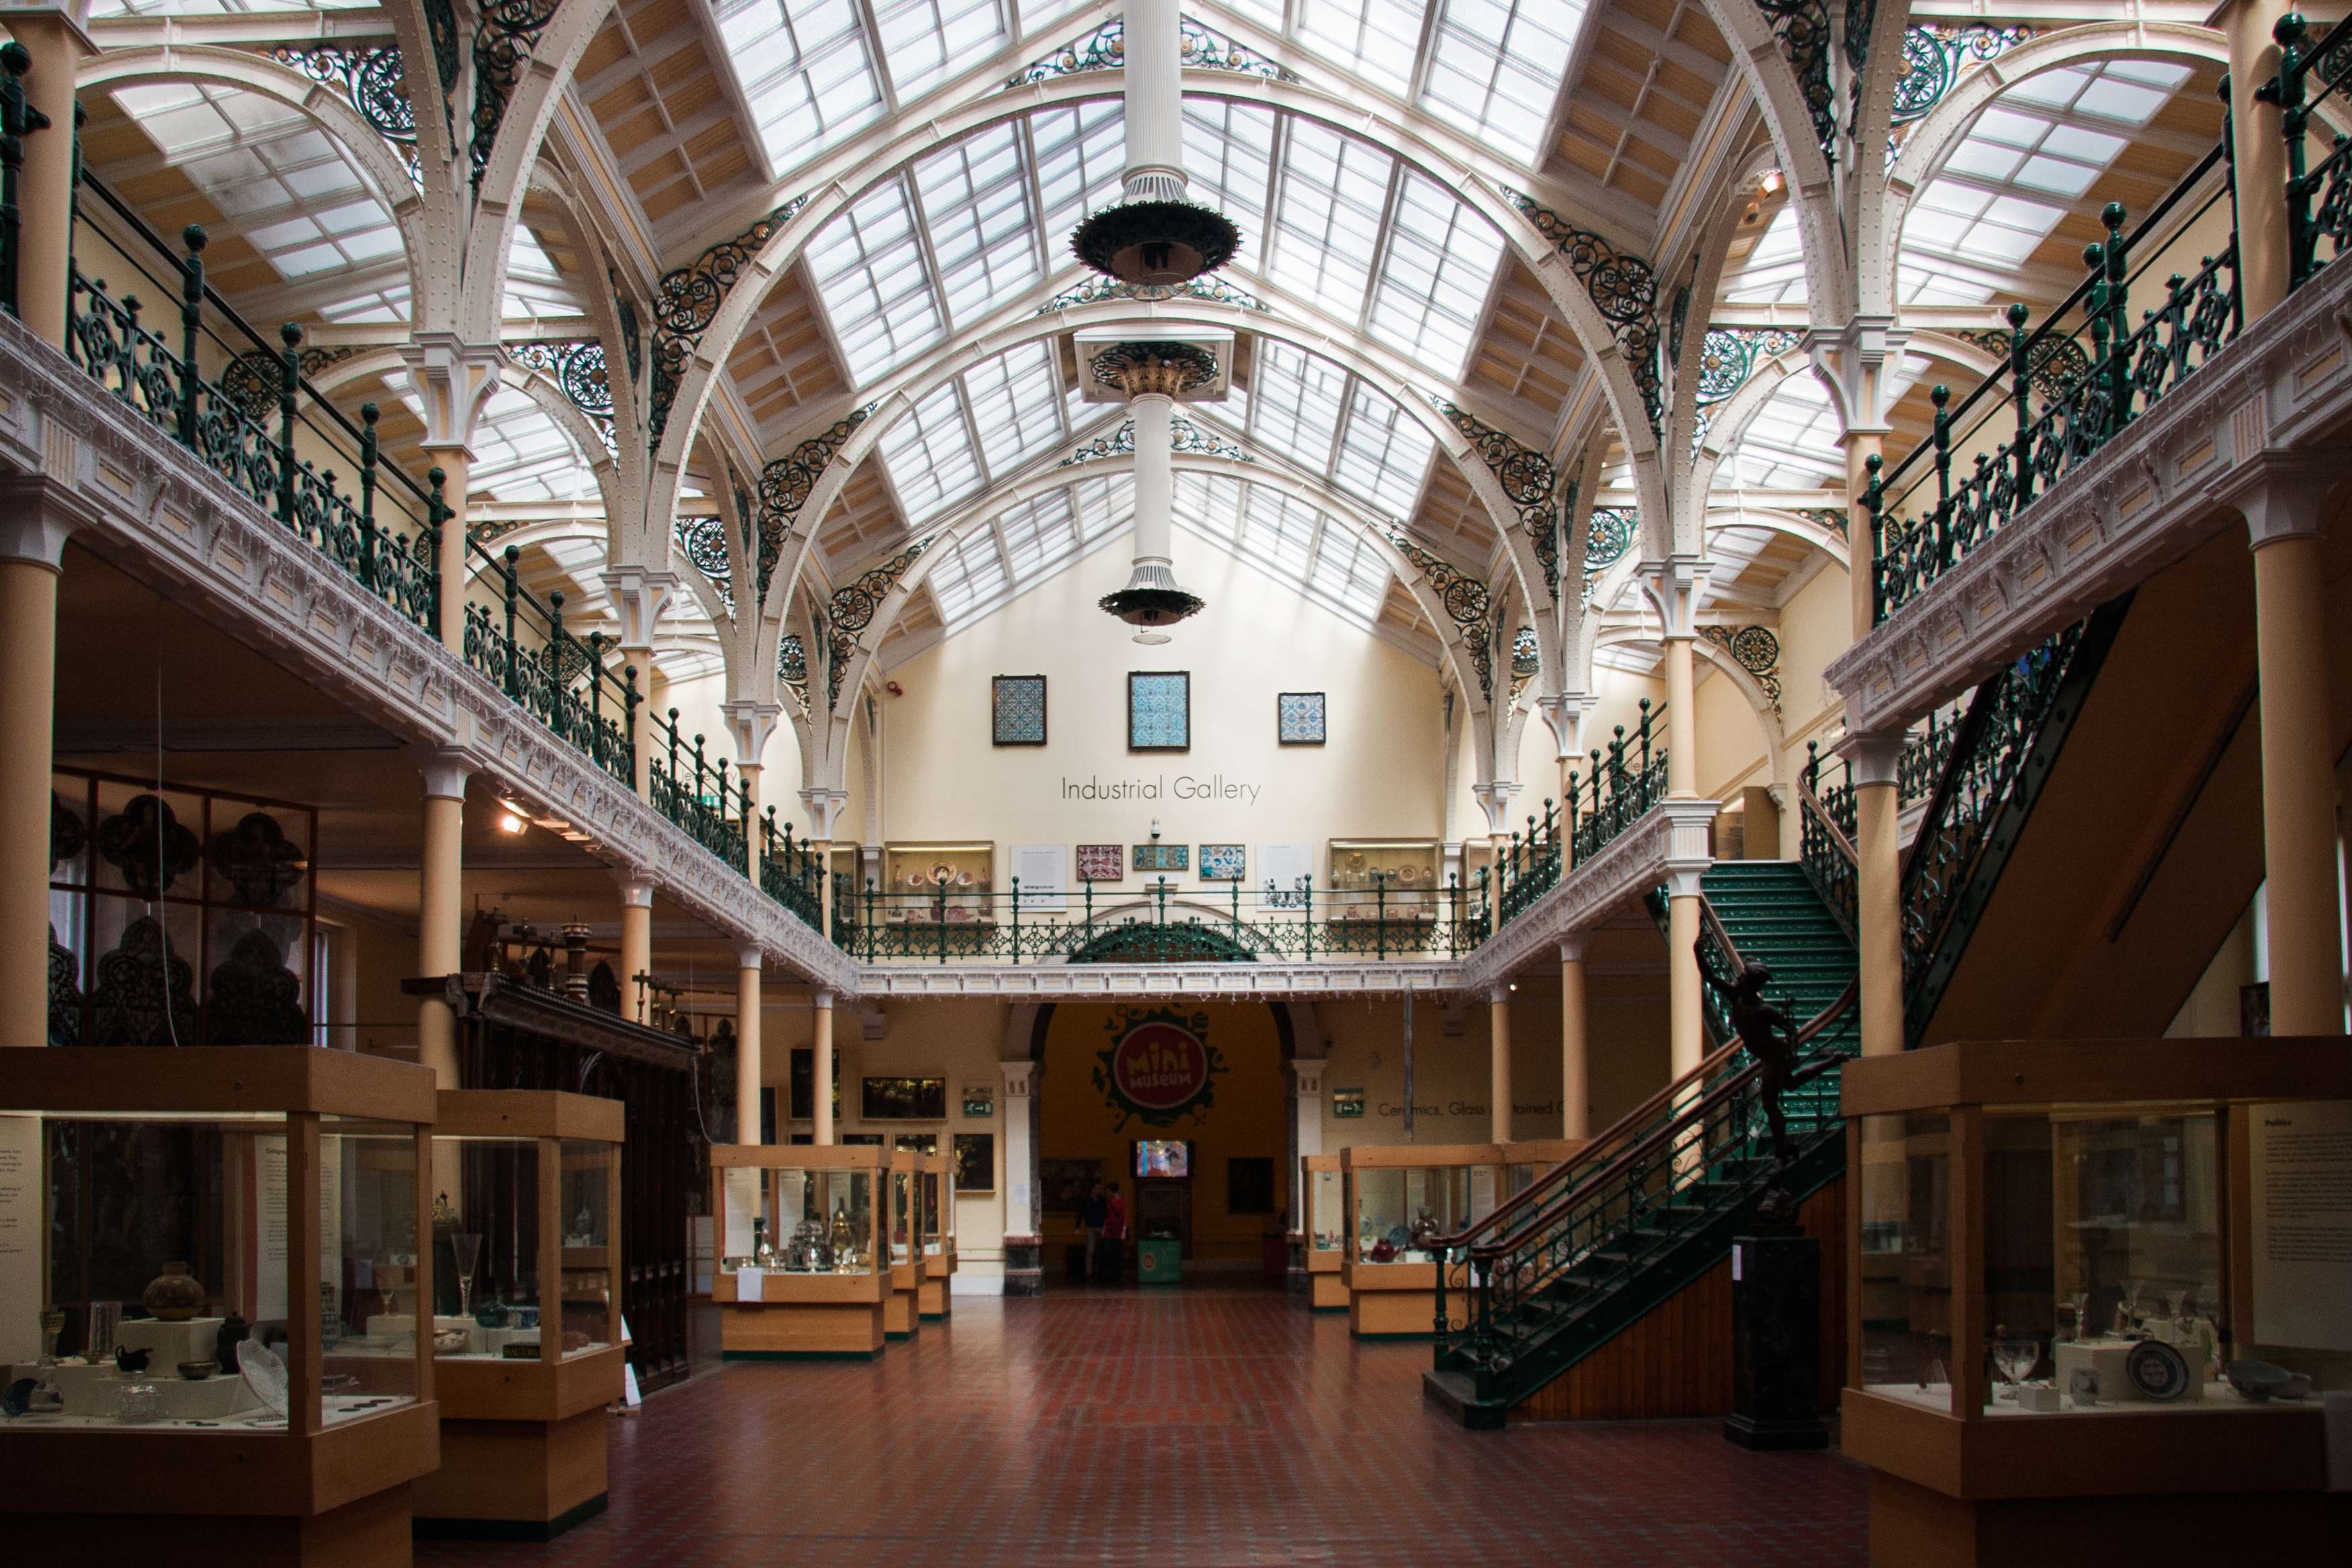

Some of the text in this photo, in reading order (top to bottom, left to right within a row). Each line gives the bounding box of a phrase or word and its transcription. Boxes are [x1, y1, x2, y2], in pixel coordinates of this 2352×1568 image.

[1063, 774, 1261, 805] Industrial Gallery
[1378, 1103, 1443, 1118] Cermics,
[1449, 1101, 1485, 1116] Glass
[1513, 1099, 1553, 1115] tained
